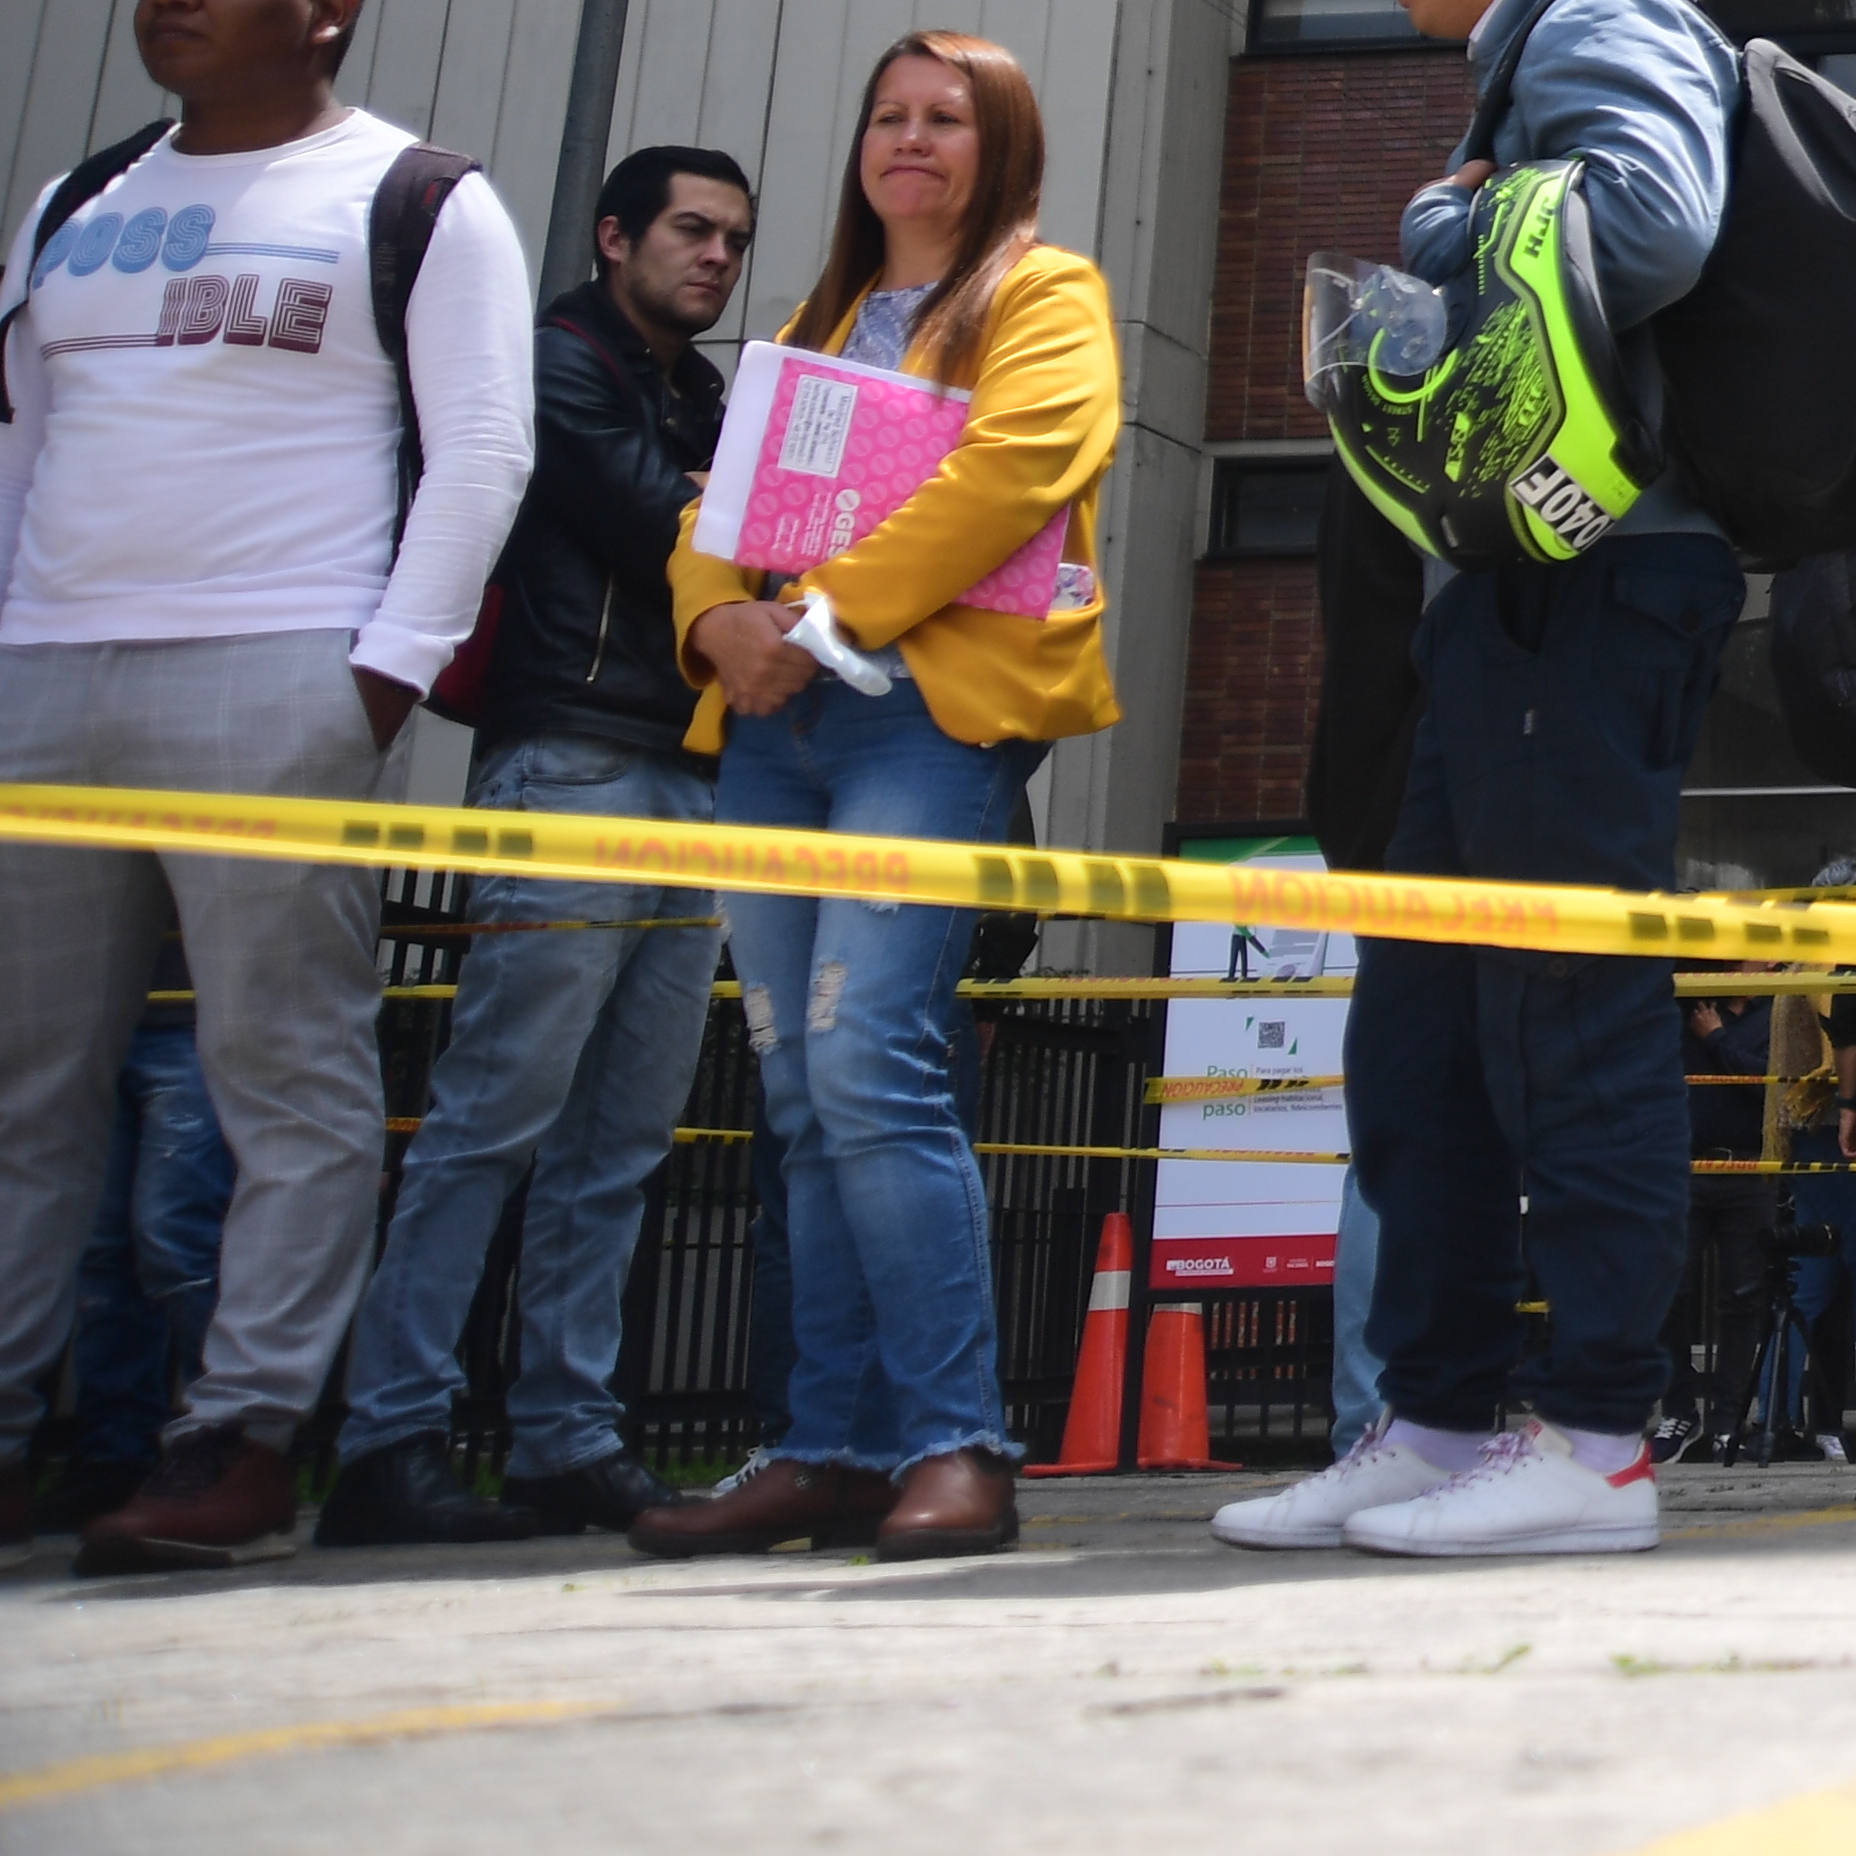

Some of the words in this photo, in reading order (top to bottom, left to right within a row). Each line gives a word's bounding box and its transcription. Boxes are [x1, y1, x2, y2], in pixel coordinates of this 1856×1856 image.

[1524, 197, 1556, 259] HJC
[33, 204, 215, 289] POSS
[156, 274, 333, 354] IBLE
[1207, 1065, 1248, 1078] Paso
[1161, 1080, 1244, 1098] PRECAUCION
[1203, 1103, 1246, 1120] paso
[1177, 1256, 1229, 1270] BOGOTÁ
